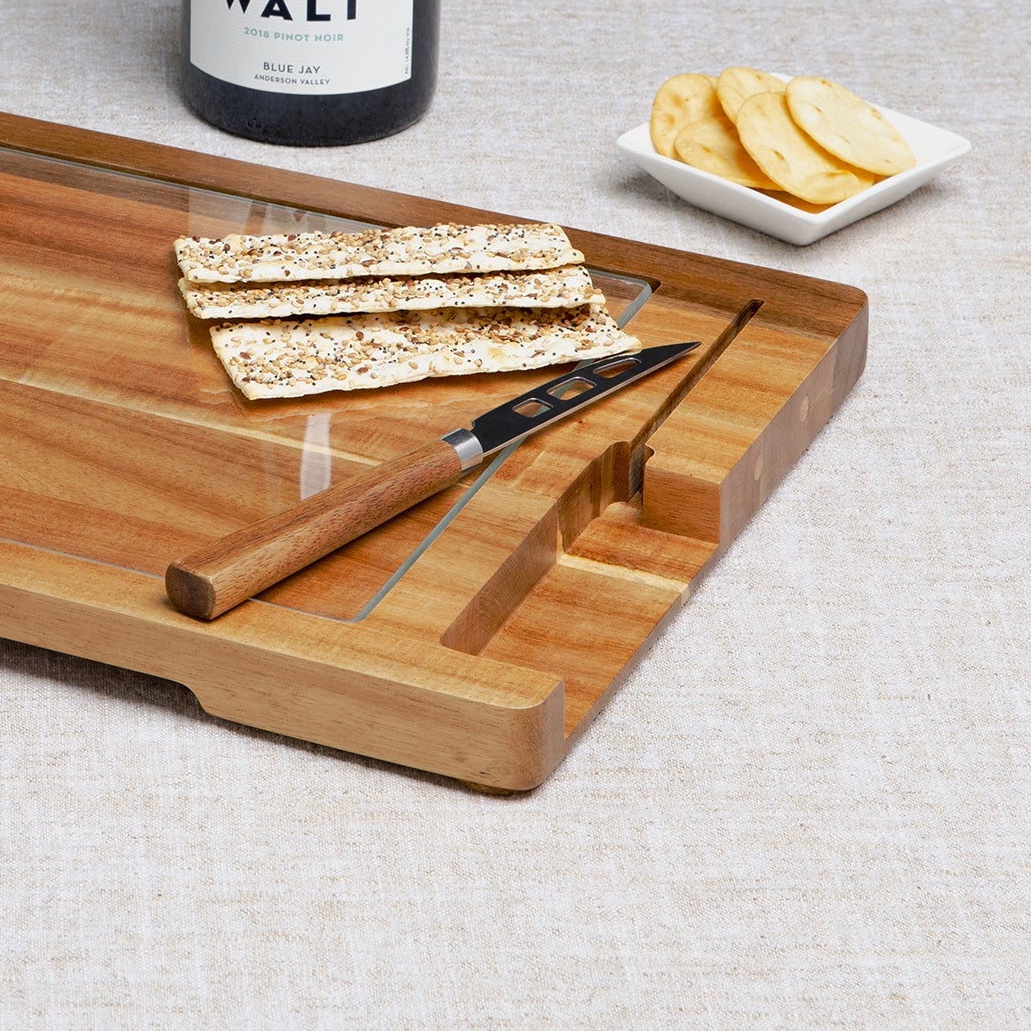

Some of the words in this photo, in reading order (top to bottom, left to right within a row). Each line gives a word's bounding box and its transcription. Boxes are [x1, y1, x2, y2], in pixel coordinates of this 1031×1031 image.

[244, 27, 270, 39] 2018
[274, 32, 310, 42] PINOT
[314, 34, 344, 42] NOIR
[263, 62, 294, 74] BLUE
[298, 66, 321, 74] JAY
[254, 74, 298, 84] ANDERSON
